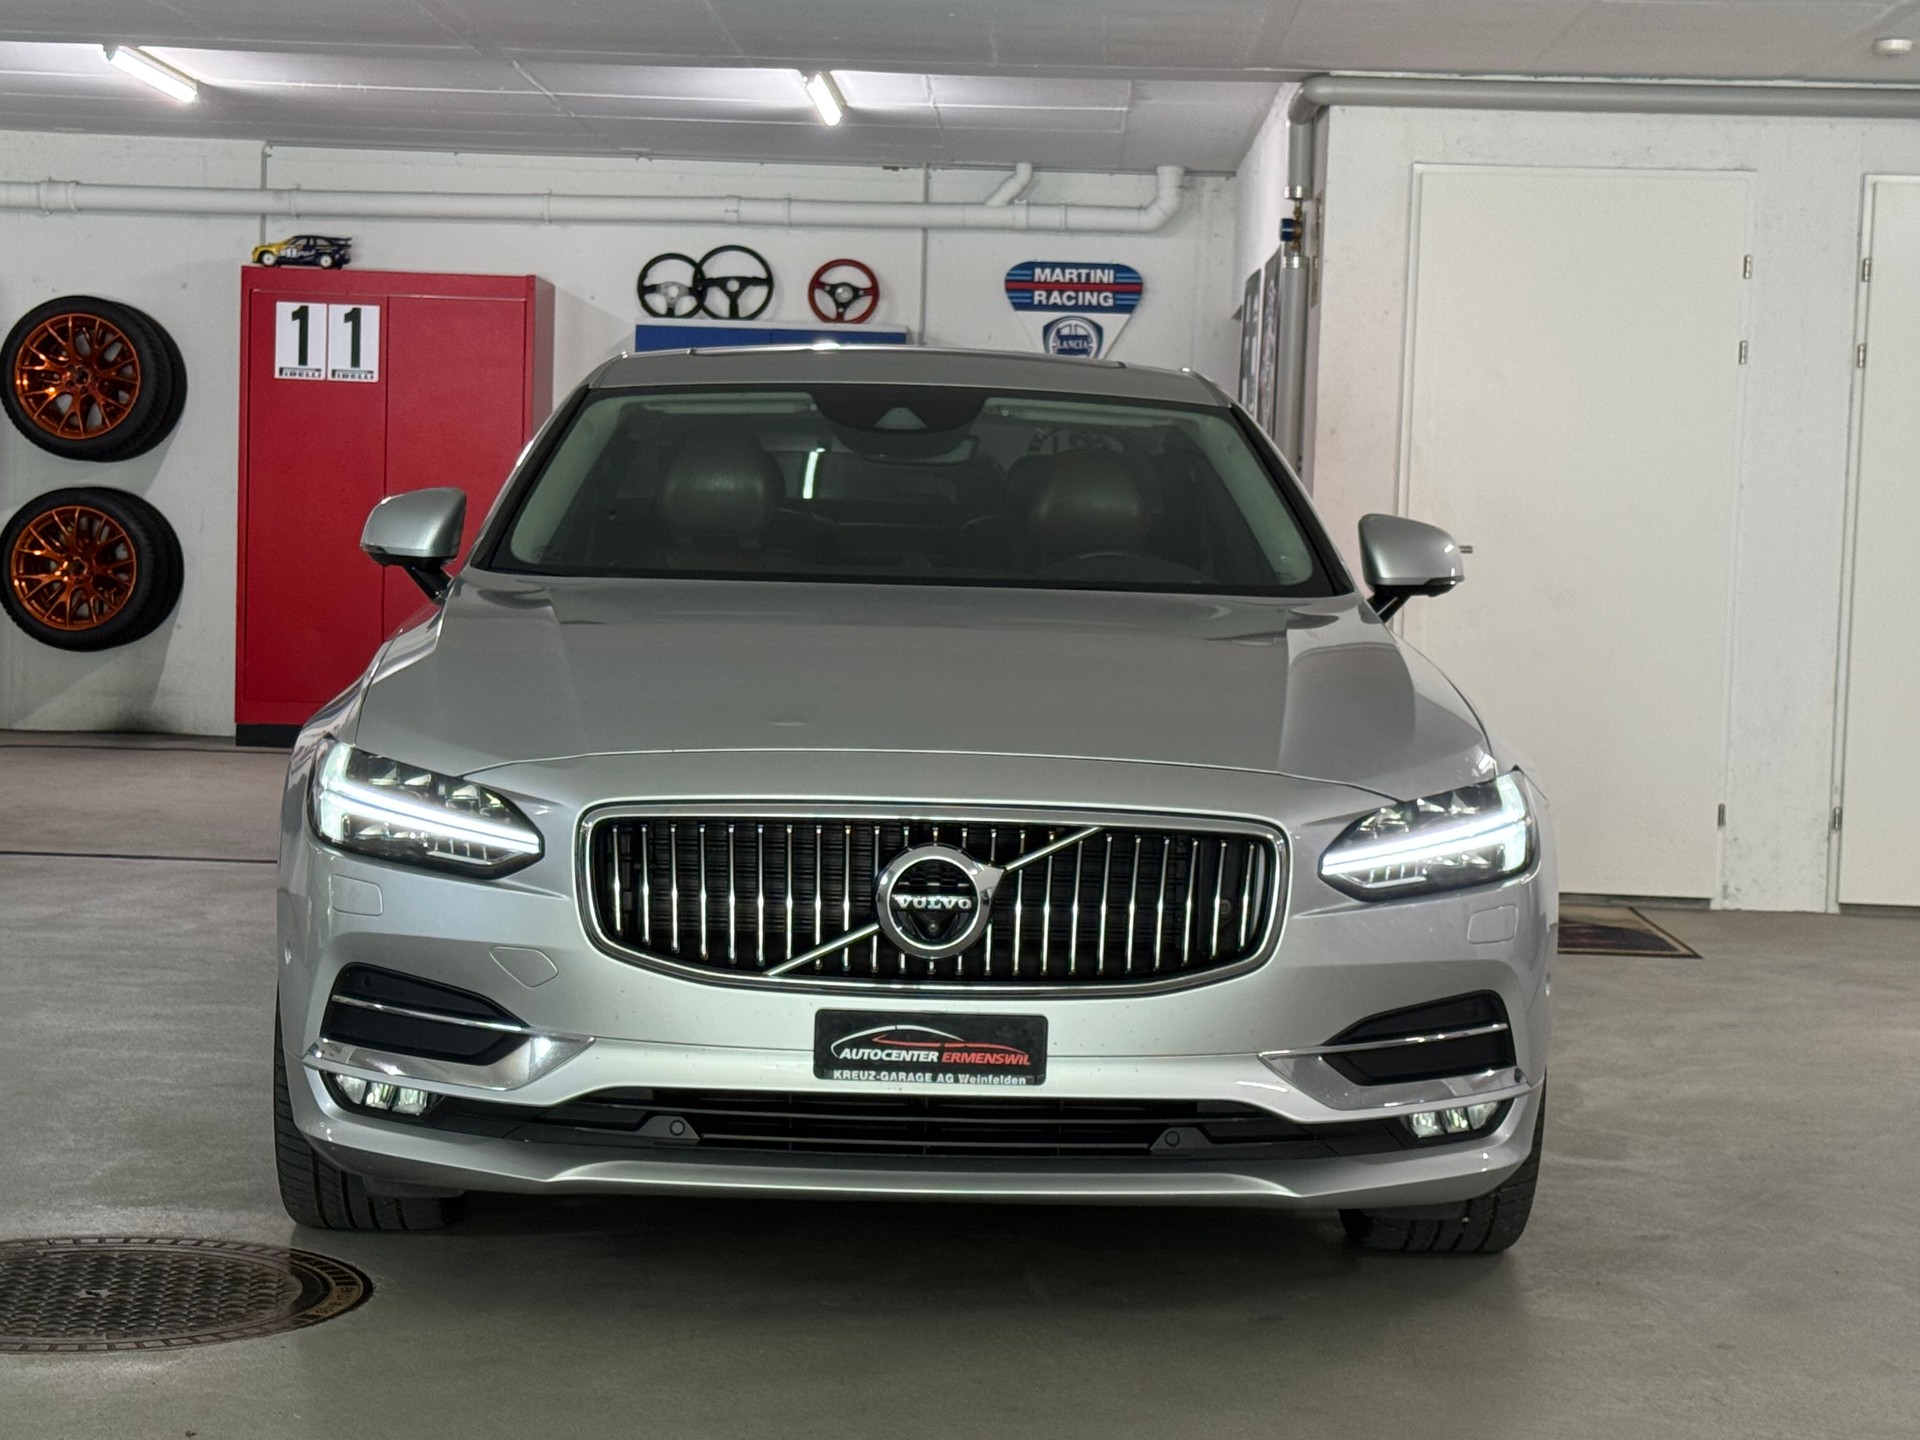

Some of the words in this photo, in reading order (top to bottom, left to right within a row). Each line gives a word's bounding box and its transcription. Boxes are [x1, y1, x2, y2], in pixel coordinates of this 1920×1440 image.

[1034, 268, 1114, 284] MARTINI
[1033, 290, 1114, 306] RACING
[1057, 339, 1089, 350] LANCIA
[892, 895, 972, 909] VOLVO
[839, 1048, 938, 1063] AUTOCENTER
[941, 1052, 1031, 1066] ERMENSWIL
[833, 1069, 932, 1082] KREUZ-GARAGE
[936, 1073, 954, 1084] AG
[958, 1074, 1026, 1085] Weinfelden
